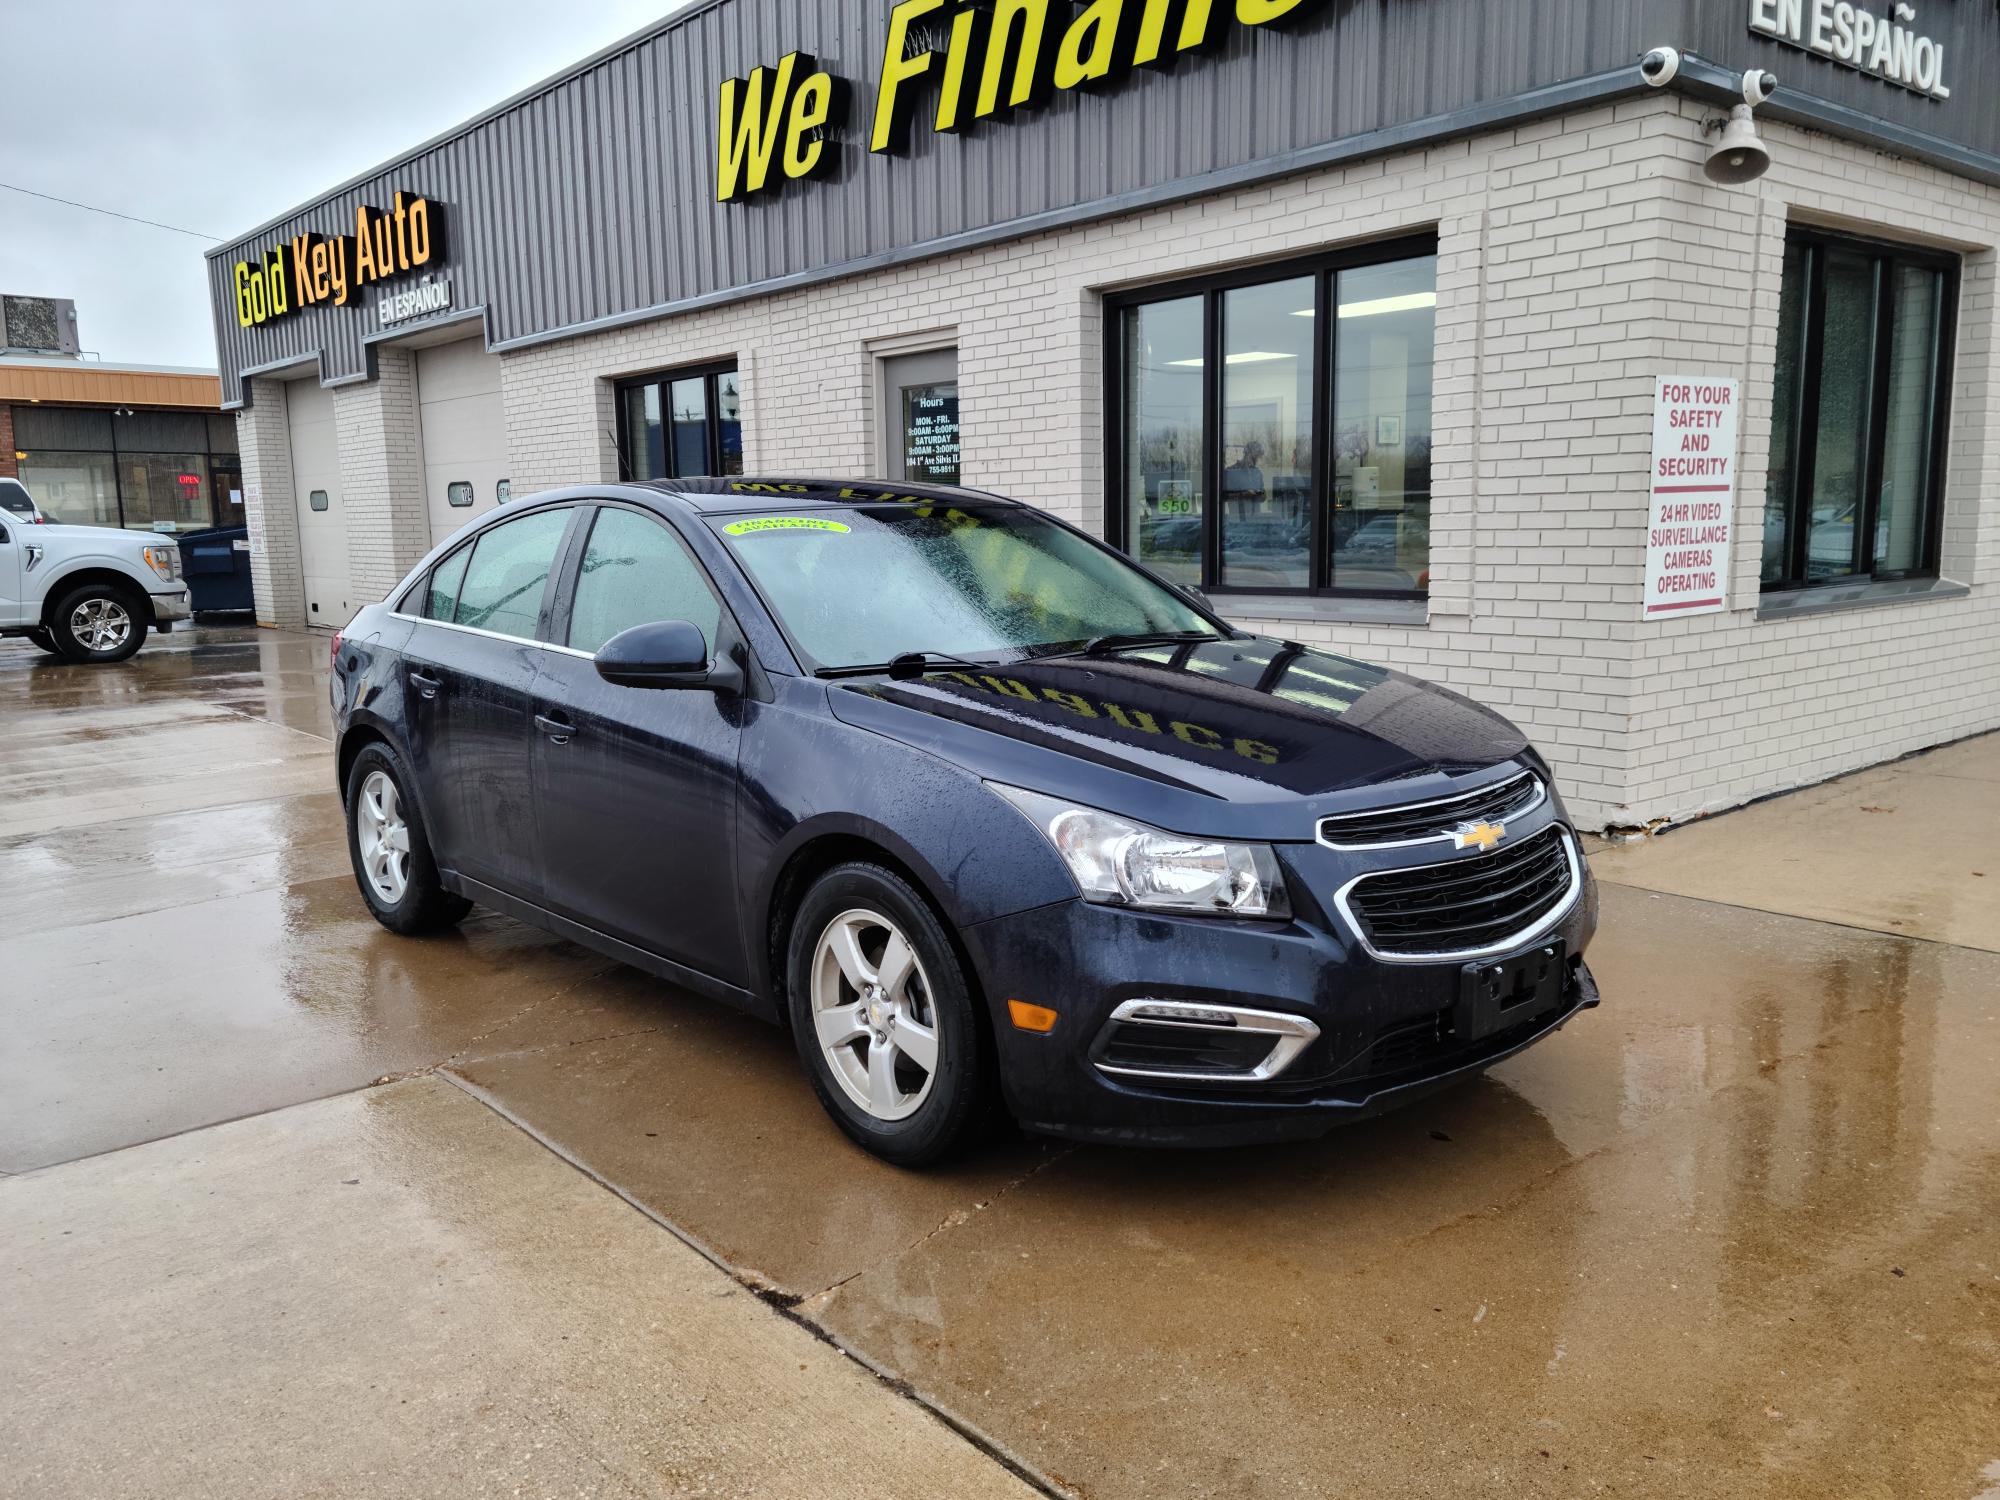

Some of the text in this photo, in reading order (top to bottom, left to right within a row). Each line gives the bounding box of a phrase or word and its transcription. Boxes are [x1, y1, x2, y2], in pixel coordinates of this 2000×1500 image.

[1751, 0, 1950, 98] EN ESPAÑOL
[716, 0, 1304, 203] We Finan
[235, 191, 430, 327] Gold Key Auto
[379, 275, 450, 323] EN ESPAÑOL
[920, 398, 944, 408] Hours
[1662, 384, 1731, 404] FOR YOUR
[1670, 410, 1723, 428] SAFETY
[915, 435, 951, 446] SATURDAY
[1681, 434, 1710, 452] AND
[936, 454, 952, 465] Silvis
[1658, 457, 1728, 477] SECURITY
[179, 475, 200, 484] OPEN
[1162, 500, 1190, 512] $50
[1660, 502, 1721, 523] 24 HR VIDEO
[1651, 525, 1728, 547] SURVEILLANCE
[1664, 549, 1713, 570] CAMERAS
[1657, 571, 1716, 594] OPERATING
